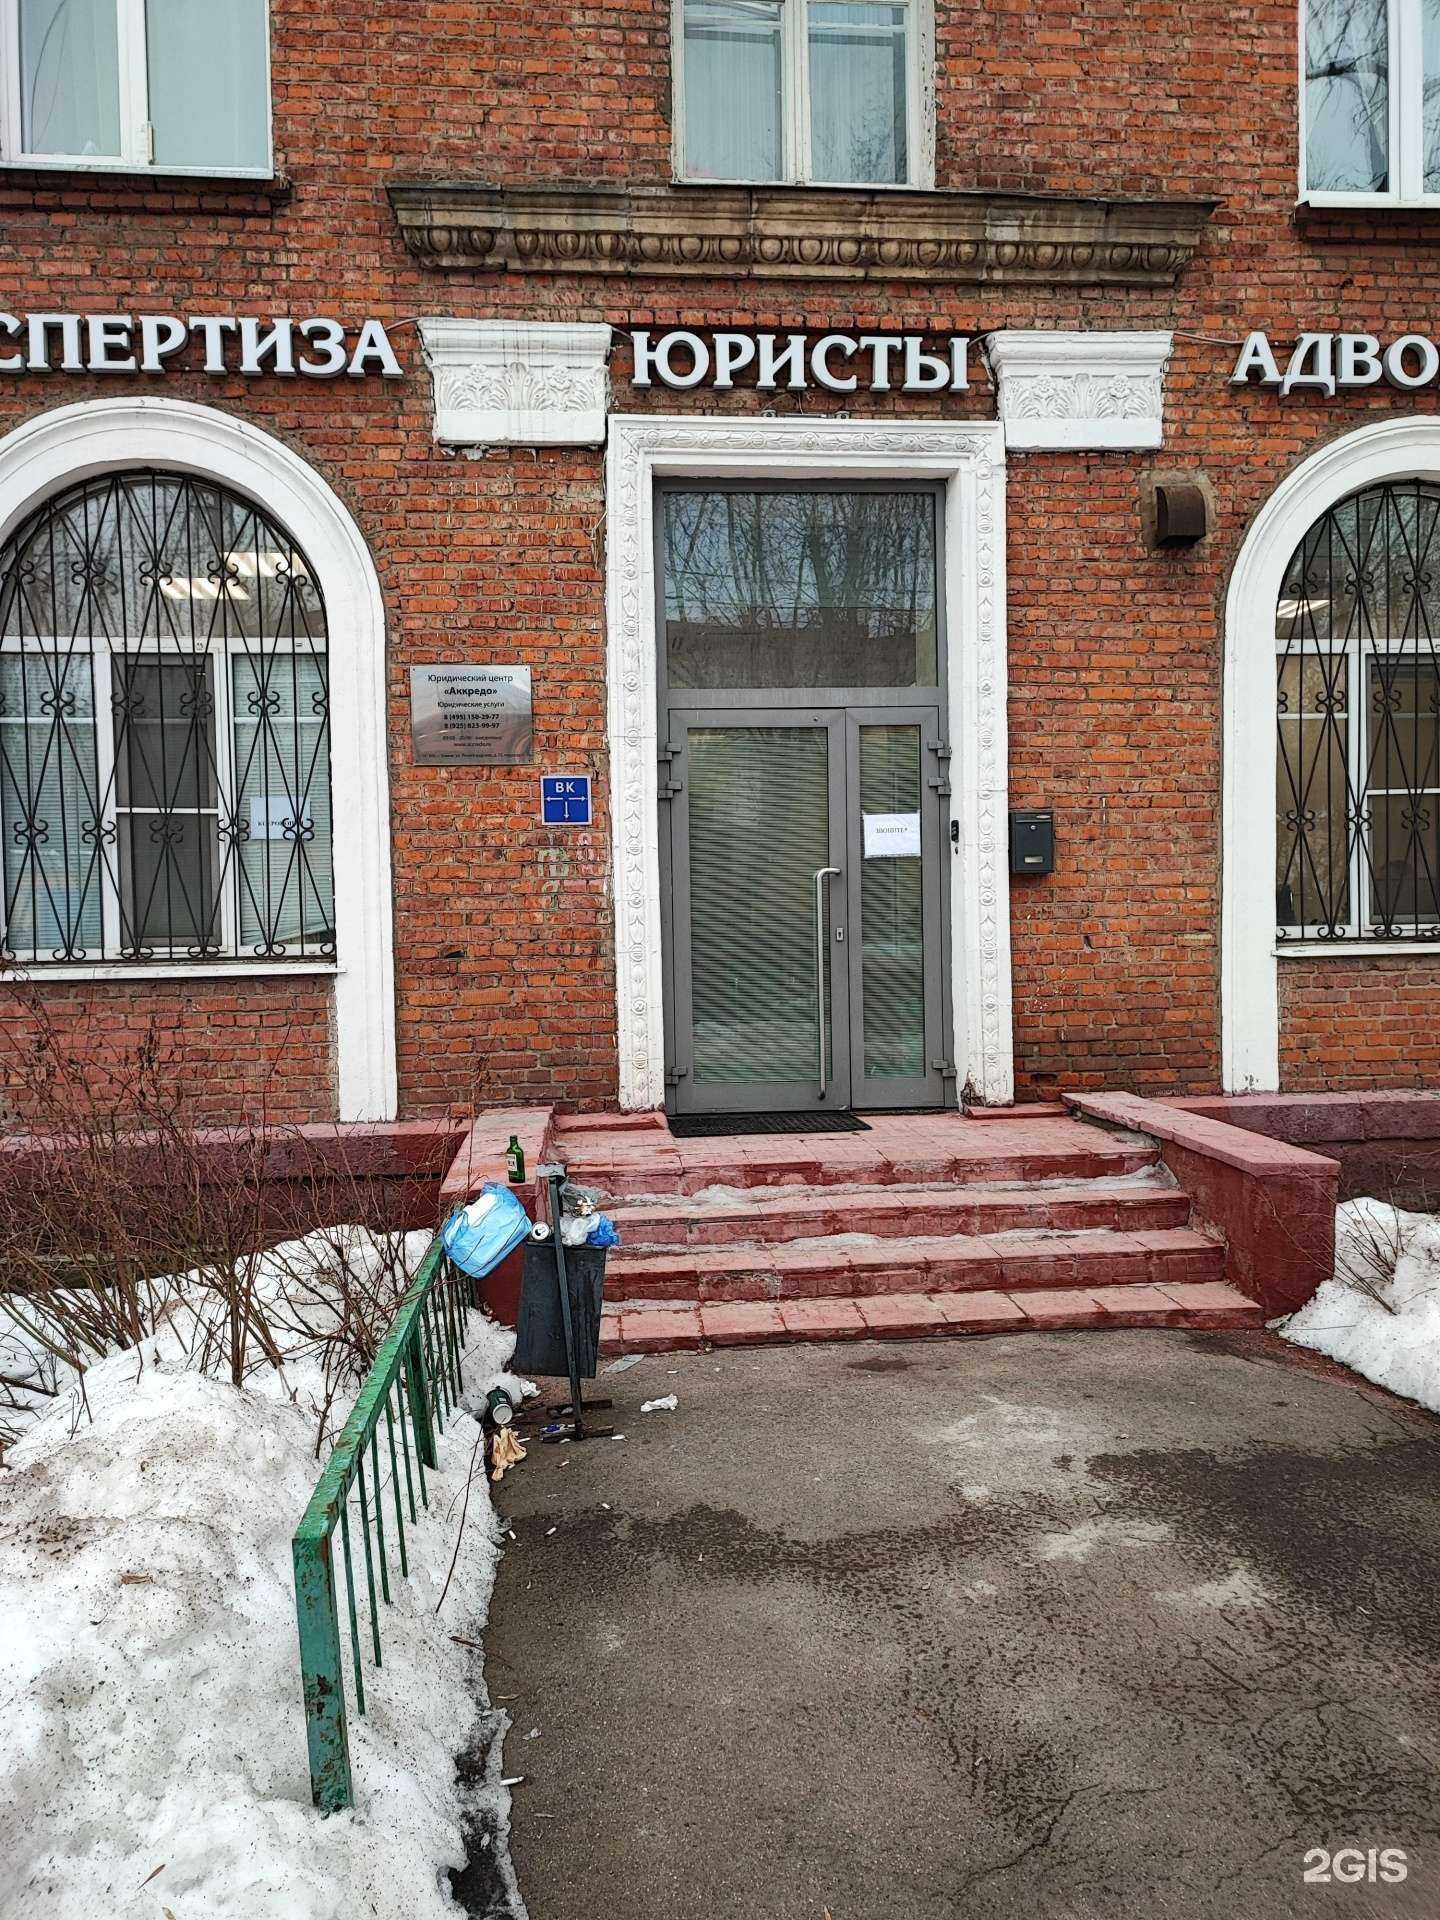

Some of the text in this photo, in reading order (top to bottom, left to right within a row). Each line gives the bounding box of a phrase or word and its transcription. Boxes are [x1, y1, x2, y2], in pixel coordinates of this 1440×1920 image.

[630, 331, 970, 393] ЮРИСТЫ
[428, 674, 514, 683] Юридический центр
[444, 687, 498, 696] «Аккредо»
[555, 781, 575, 793] ВК
